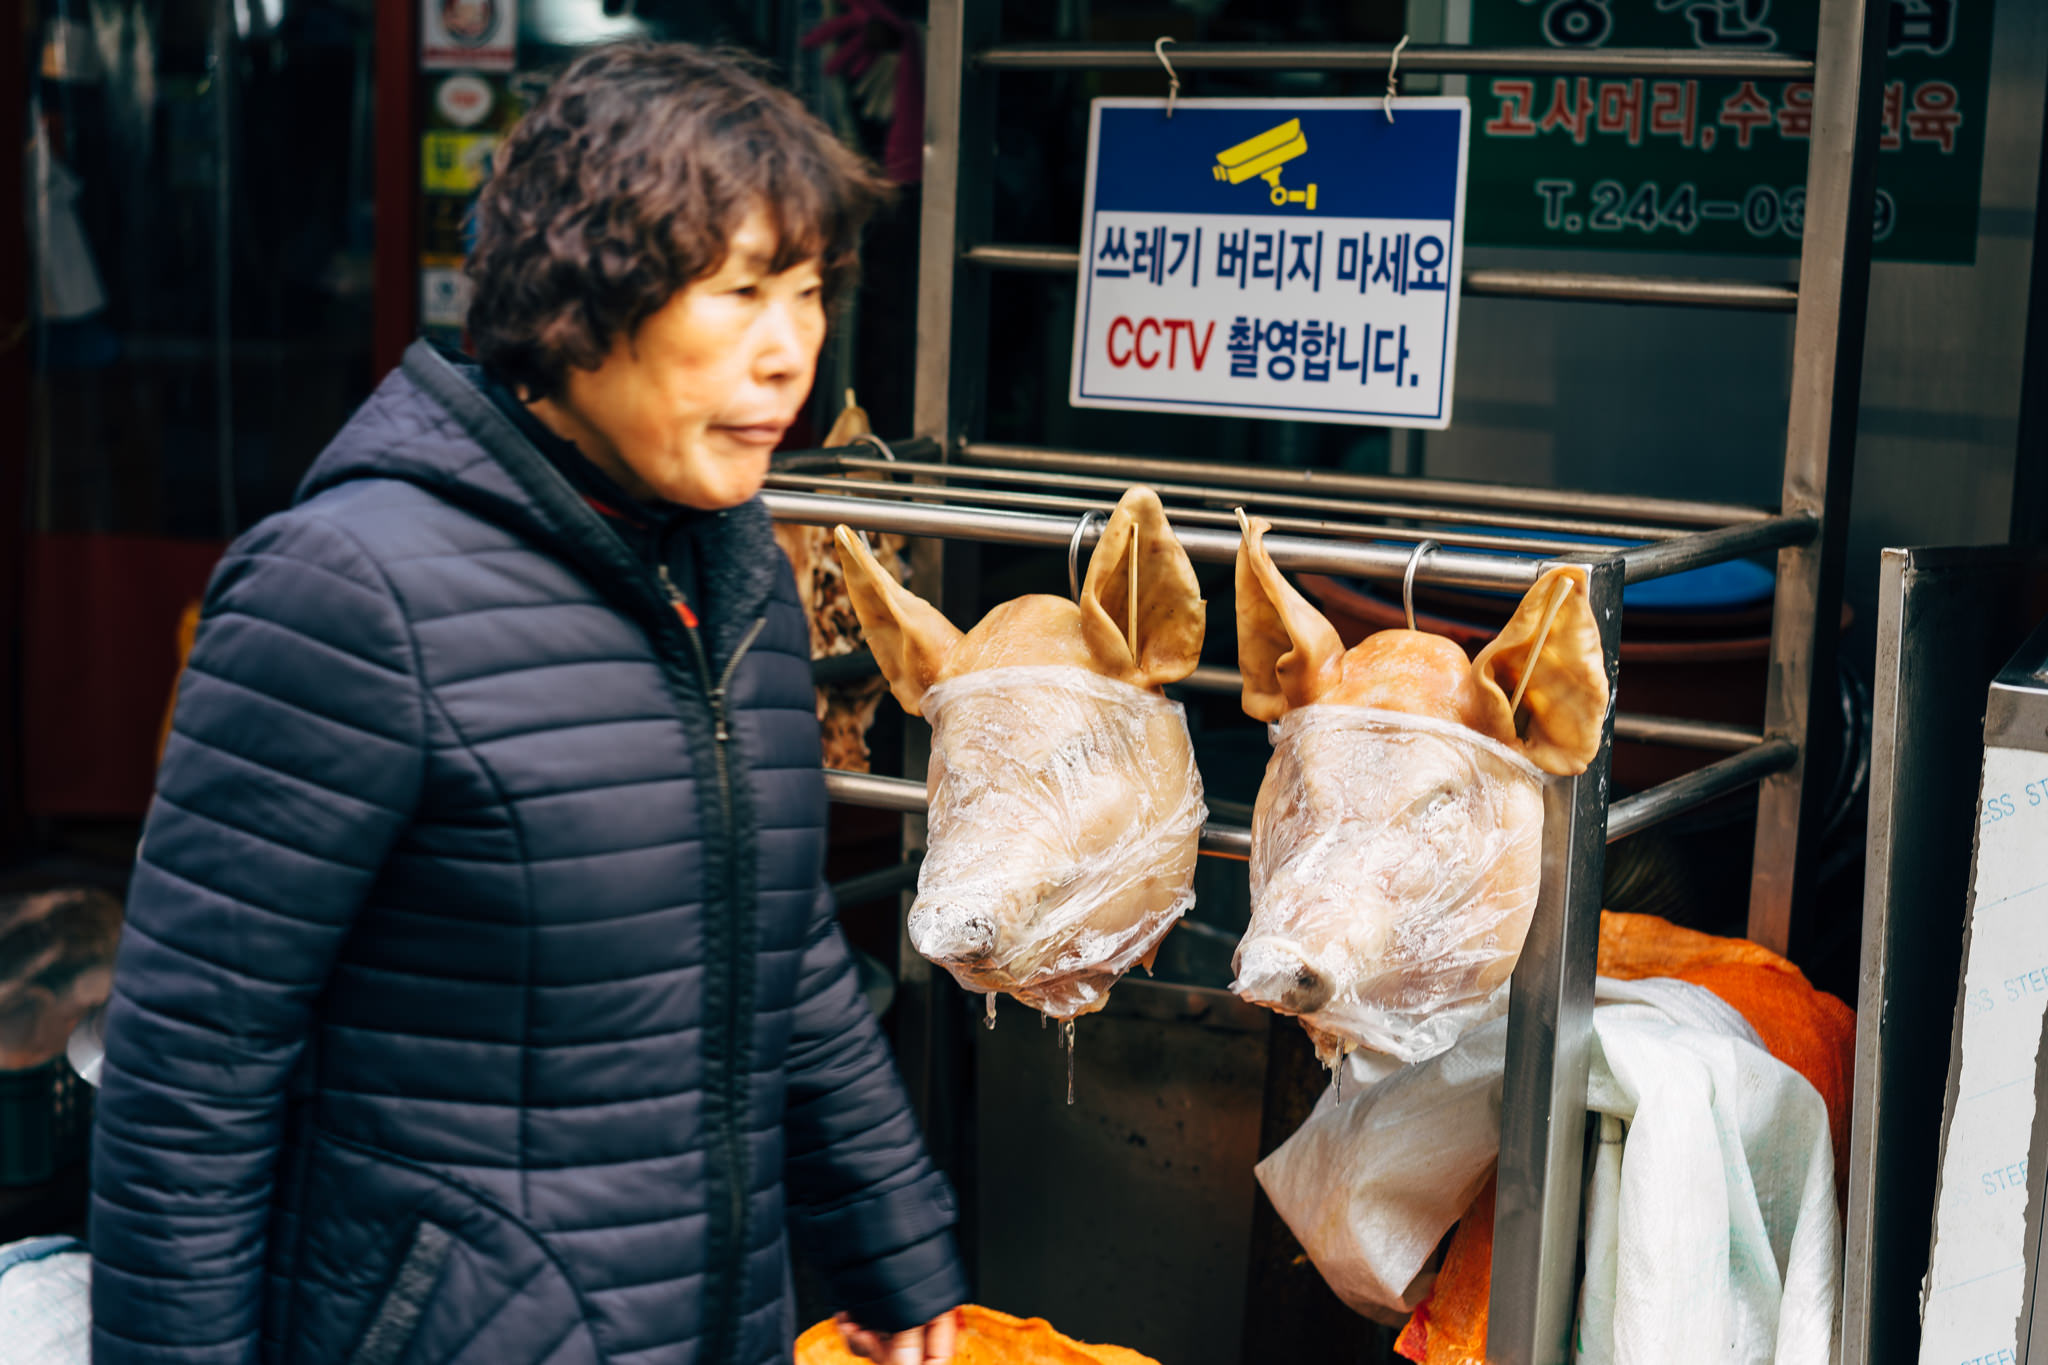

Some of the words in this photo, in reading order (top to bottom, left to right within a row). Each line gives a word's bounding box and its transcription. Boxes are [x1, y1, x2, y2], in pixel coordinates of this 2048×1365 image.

[1535, 179, 1895, 240] T.244-039
[1096, 226, 1202, 287] 쓰레기
[1216, 229, 1323, 292] 버리지
[1336, 231, 1447, 295] 마세요
[1106, 315, 1215, 371] CCTV
[1226, 316, 1419, 387] 촬영합니다.
